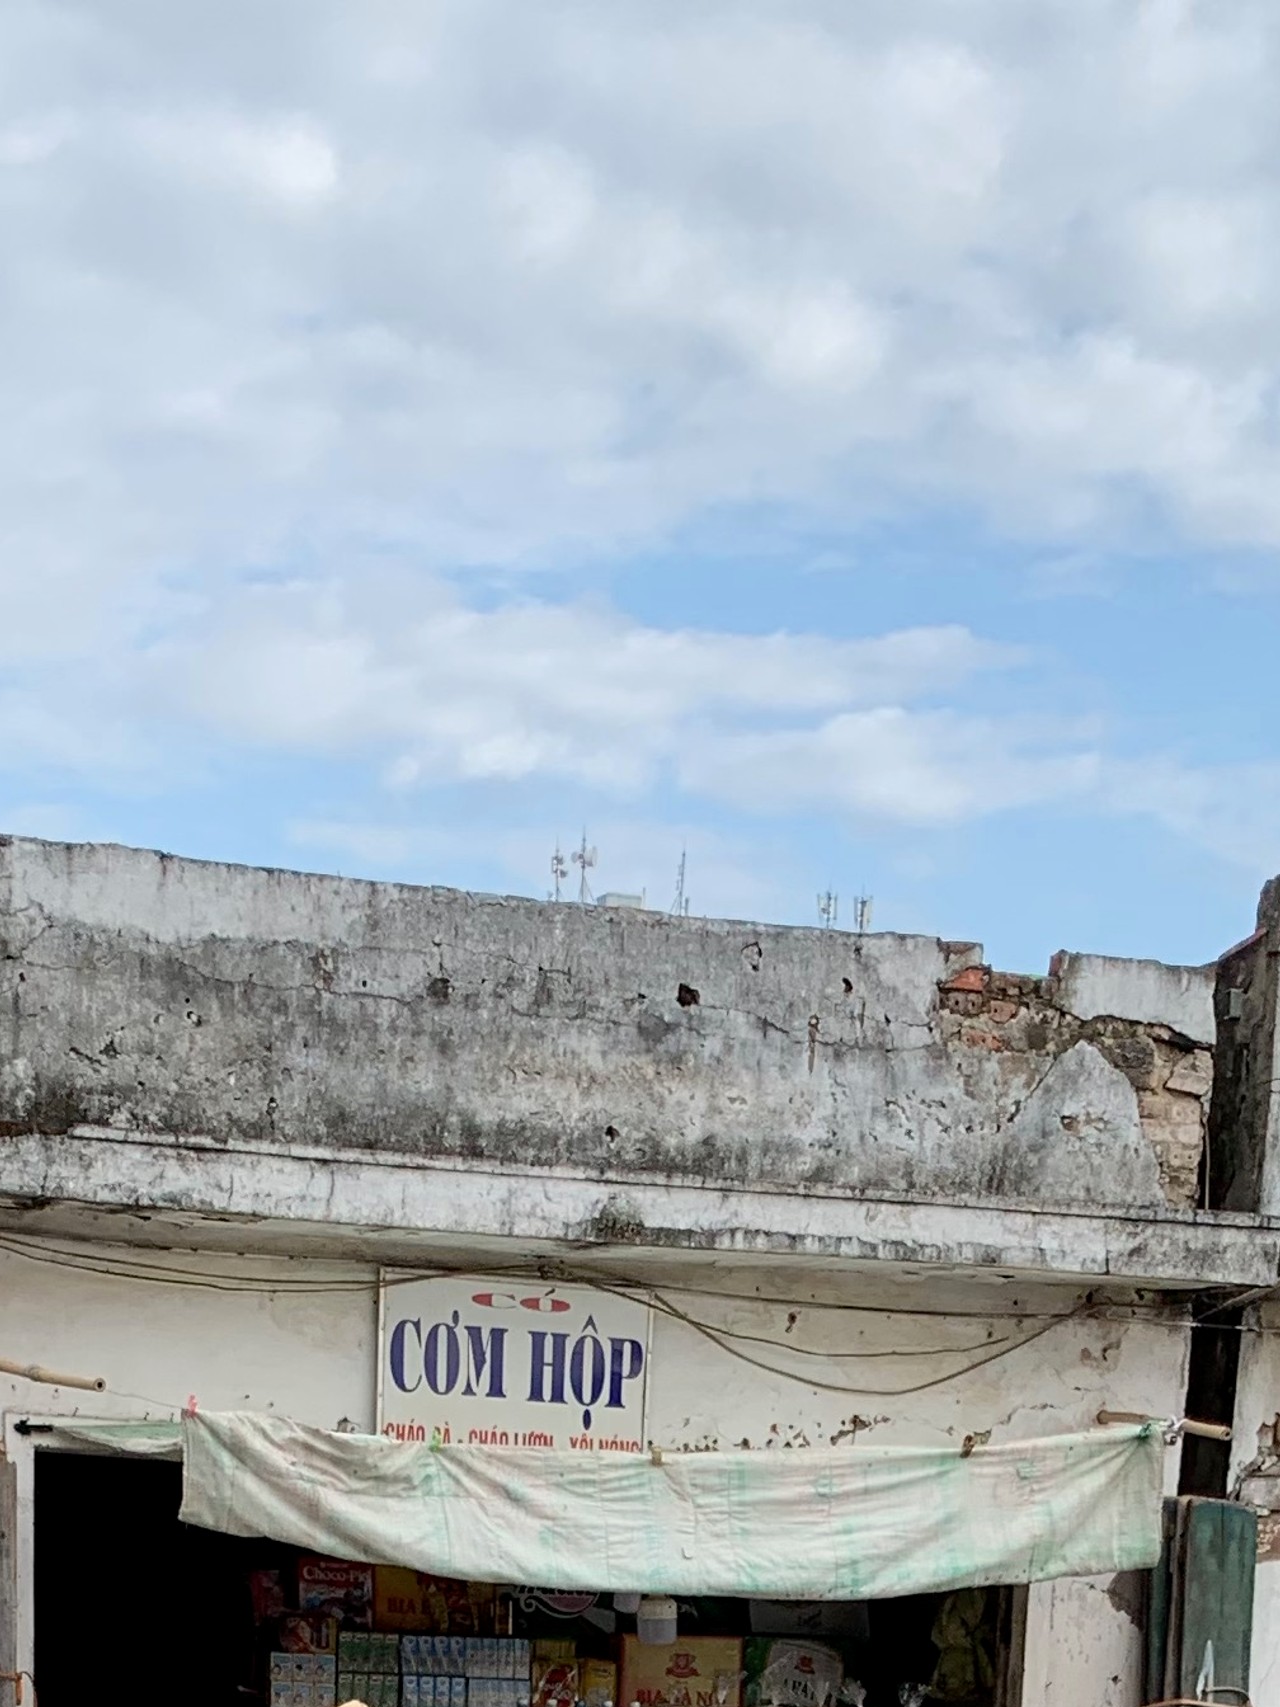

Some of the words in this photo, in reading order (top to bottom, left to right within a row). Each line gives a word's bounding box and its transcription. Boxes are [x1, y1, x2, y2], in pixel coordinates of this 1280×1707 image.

[471, 1288, 571, 1313] CÓ
[390, 1310, 508, 1398] CƠM
[527, 1314, 643, 1430] HỘP
